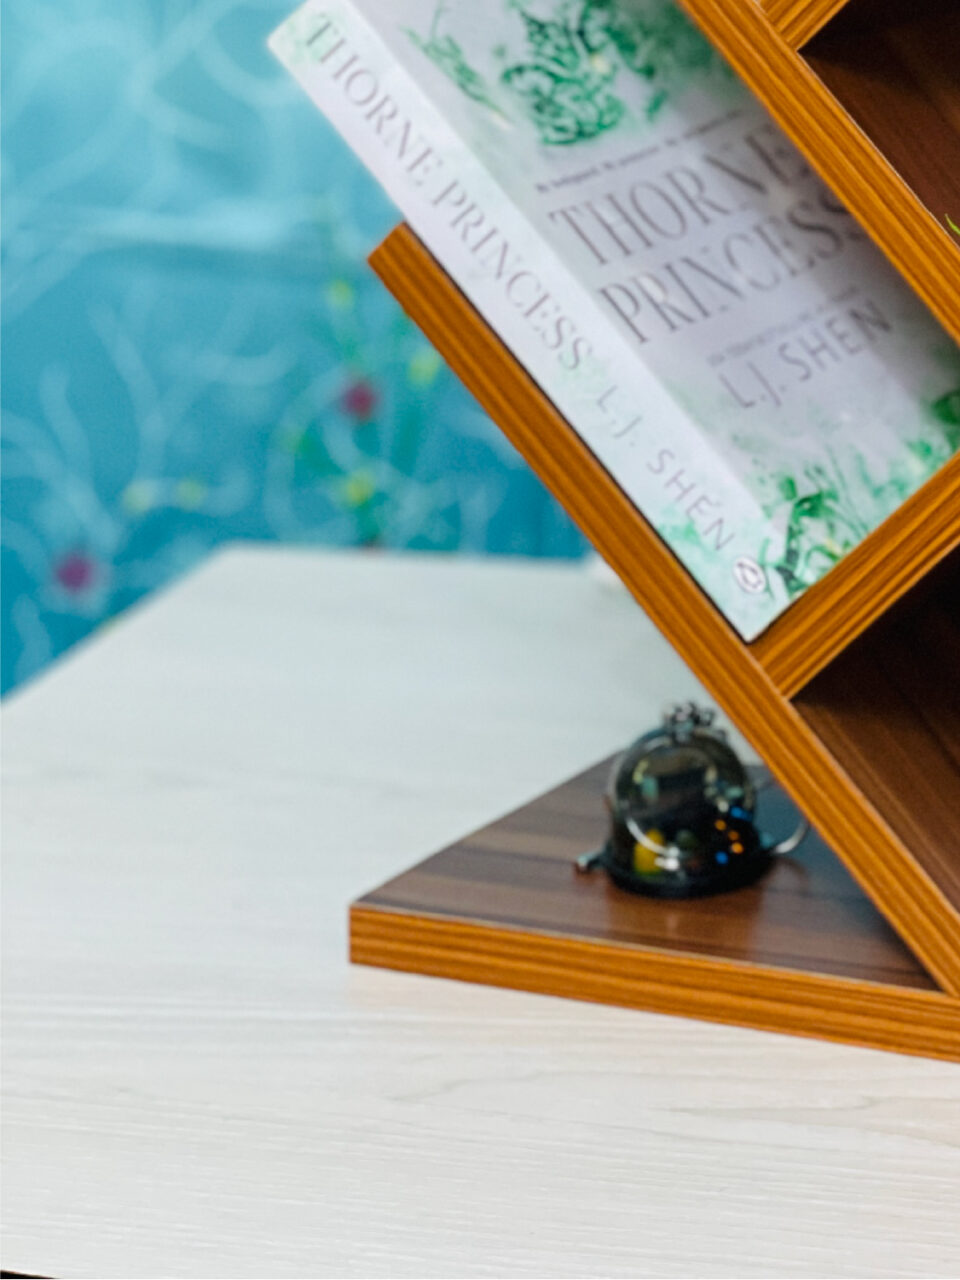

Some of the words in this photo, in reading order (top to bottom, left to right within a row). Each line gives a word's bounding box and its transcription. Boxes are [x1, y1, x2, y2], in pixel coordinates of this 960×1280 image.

[305, 11, 445, 194] THORNE
[429, 171, 594, 372] PRINCESS
[645, 447, 737, 552] SHEN
[779, 297, 897, 384] SHEN
